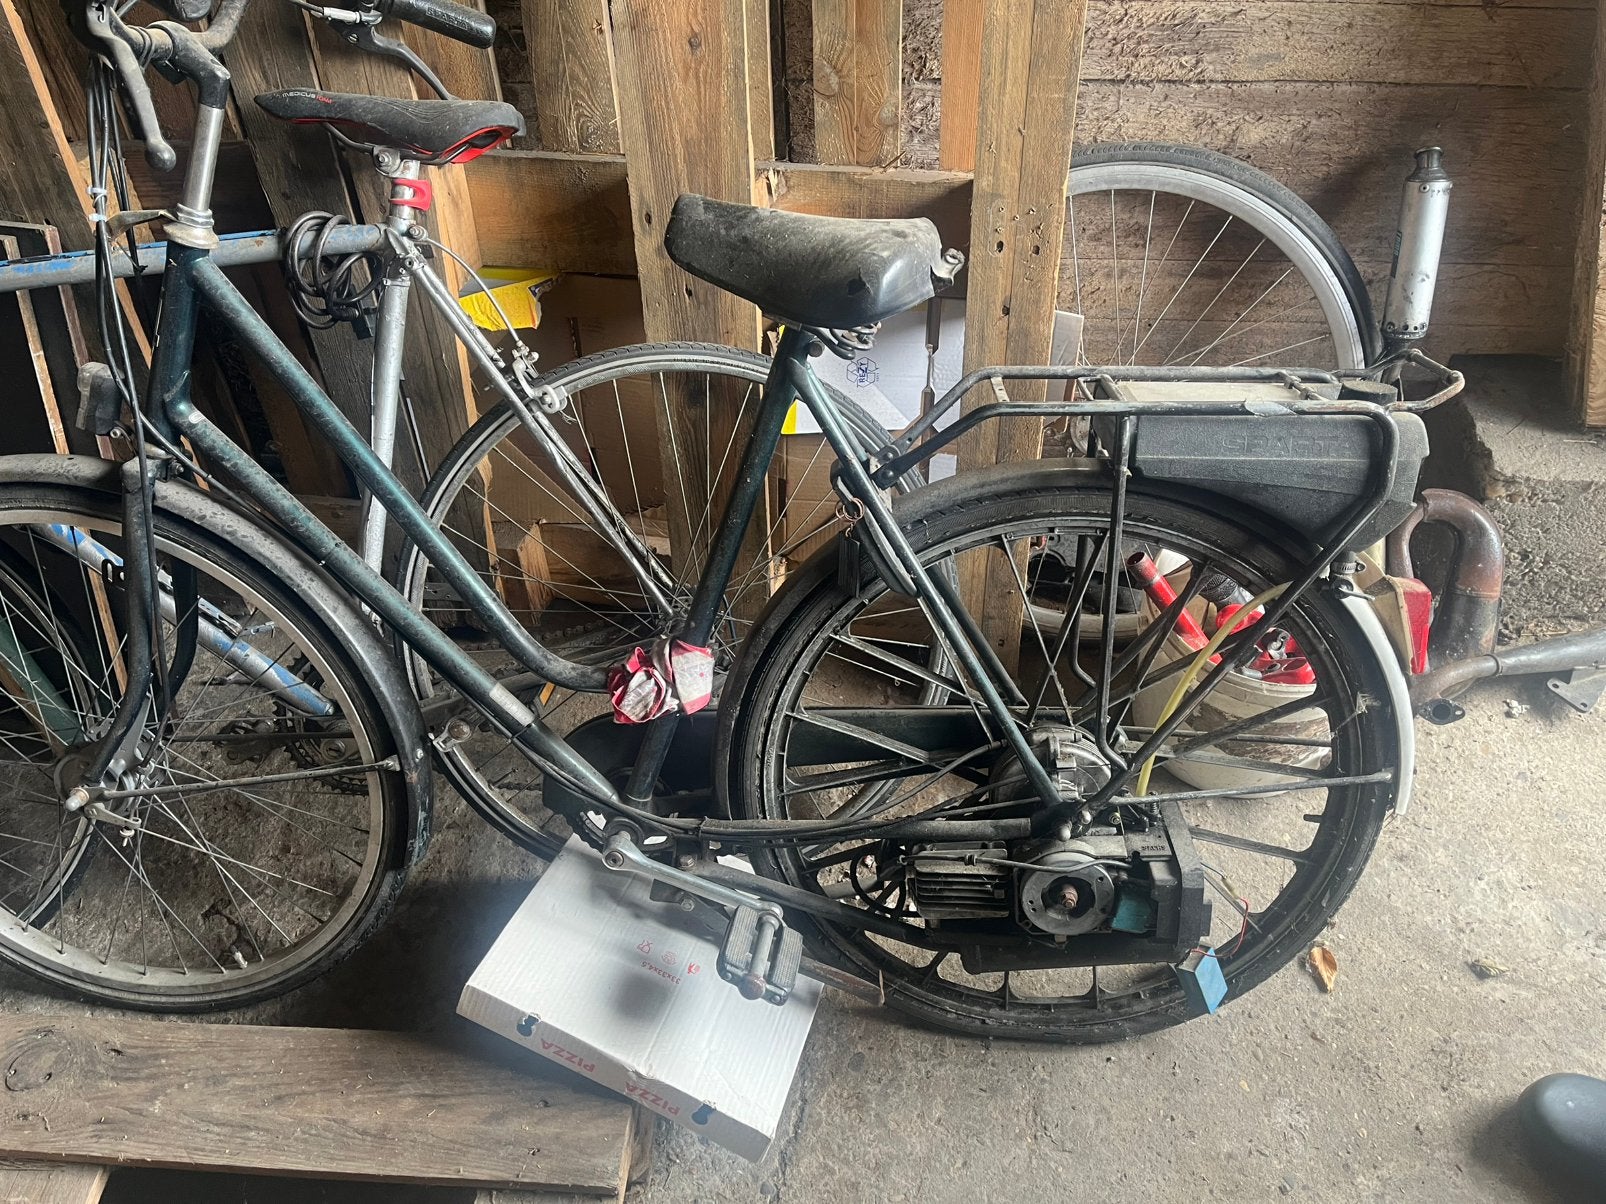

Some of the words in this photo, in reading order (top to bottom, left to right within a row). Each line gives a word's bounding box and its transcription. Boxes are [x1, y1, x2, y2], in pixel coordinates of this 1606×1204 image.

[282, 91, 316, 99] MEDICUS
[857, 361, 868, 383] REZY
[1221, 434, 1361, 456] SPARTA
[540, 1038, 596, 1073] PIZZA
[625, 1081, 681, 1116] PIZZA
